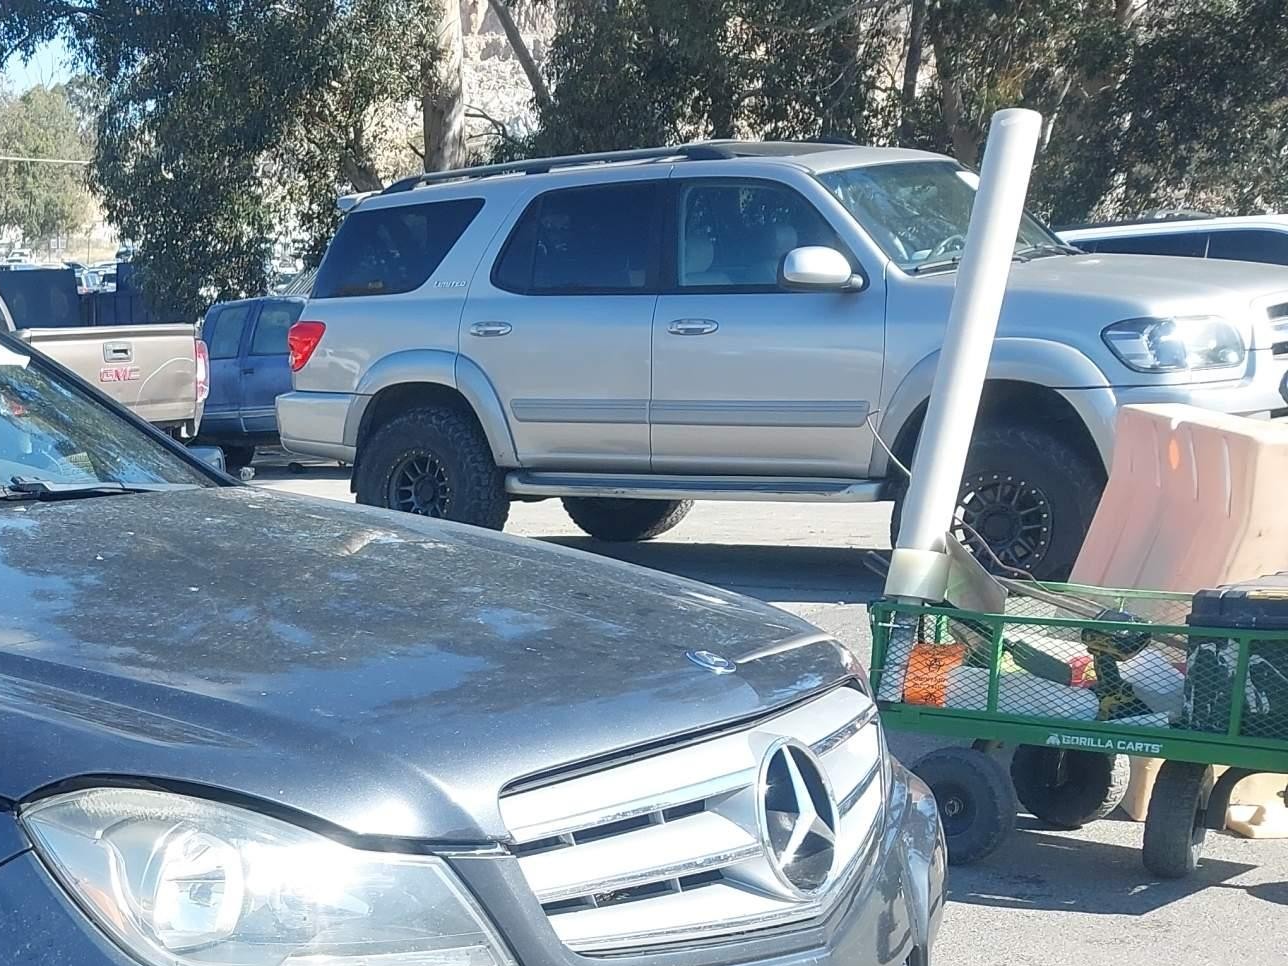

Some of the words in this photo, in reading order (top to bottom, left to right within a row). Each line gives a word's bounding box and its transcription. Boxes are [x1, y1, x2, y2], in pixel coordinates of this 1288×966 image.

[100, 367, 140, 383] GMC
[1062, 734, 1114, 750] GORILLA
[1116, 739, 1161, 754] CARTS
